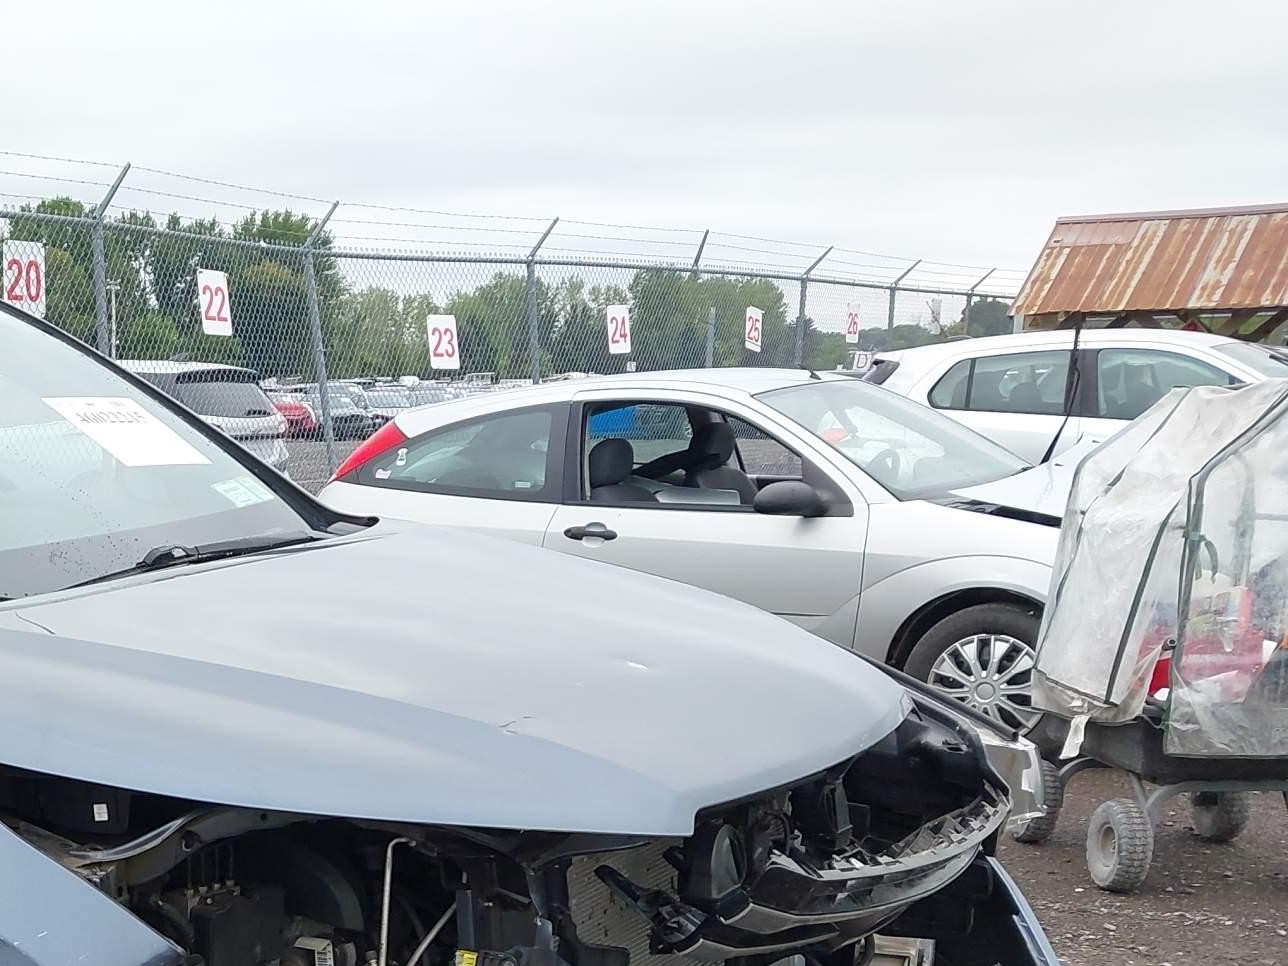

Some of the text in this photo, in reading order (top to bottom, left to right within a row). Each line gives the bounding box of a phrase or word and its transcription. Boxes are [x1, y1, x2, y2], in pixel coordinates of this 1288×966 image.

[7, 258, 41, 302] 20
[202, 285, 228, 321] 22
[610, 316, 627, 344] 24
[747, 315, 760, 342] 25
[847, 312, 858, 335] 26
[432, 327, 455, 358] 23
